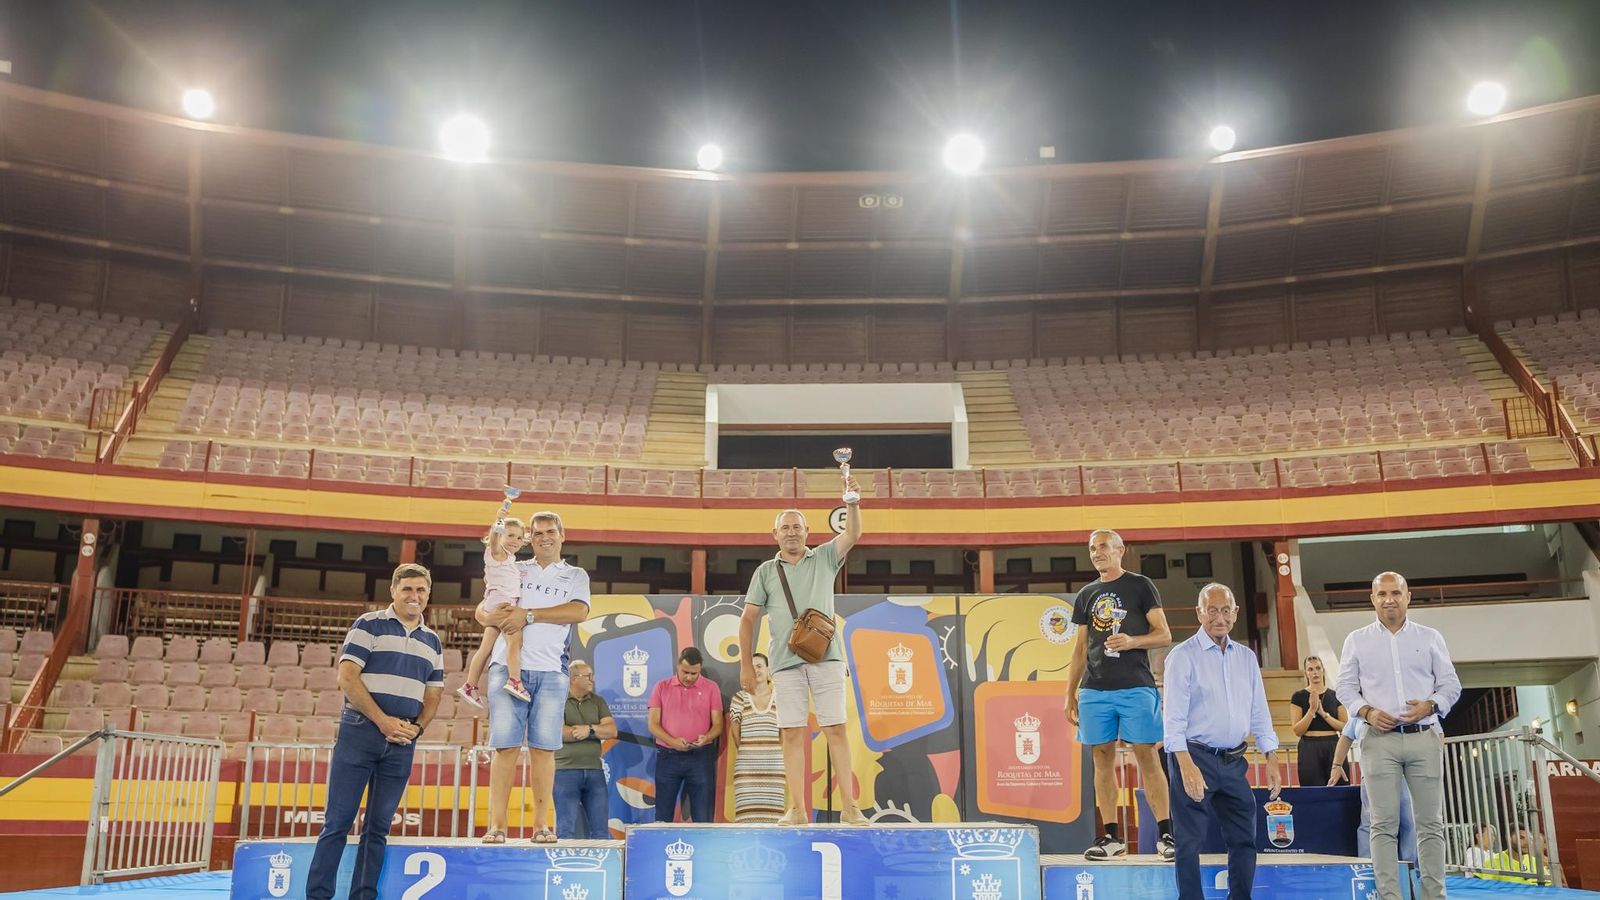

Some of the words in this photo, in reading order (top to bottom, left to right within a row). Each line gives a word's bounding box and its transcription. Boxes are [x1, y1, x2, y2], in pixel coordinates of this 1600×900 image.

[520, 582, 568, 598] CKETT
[997, 770, 1032, 779] ROQUETAS
[1044, 770, 1061, 778] MAR
[284, 810, 421, 826] MEOS
[401, 852, 447, 900] 2
[812, 842, 842, 900] 1
